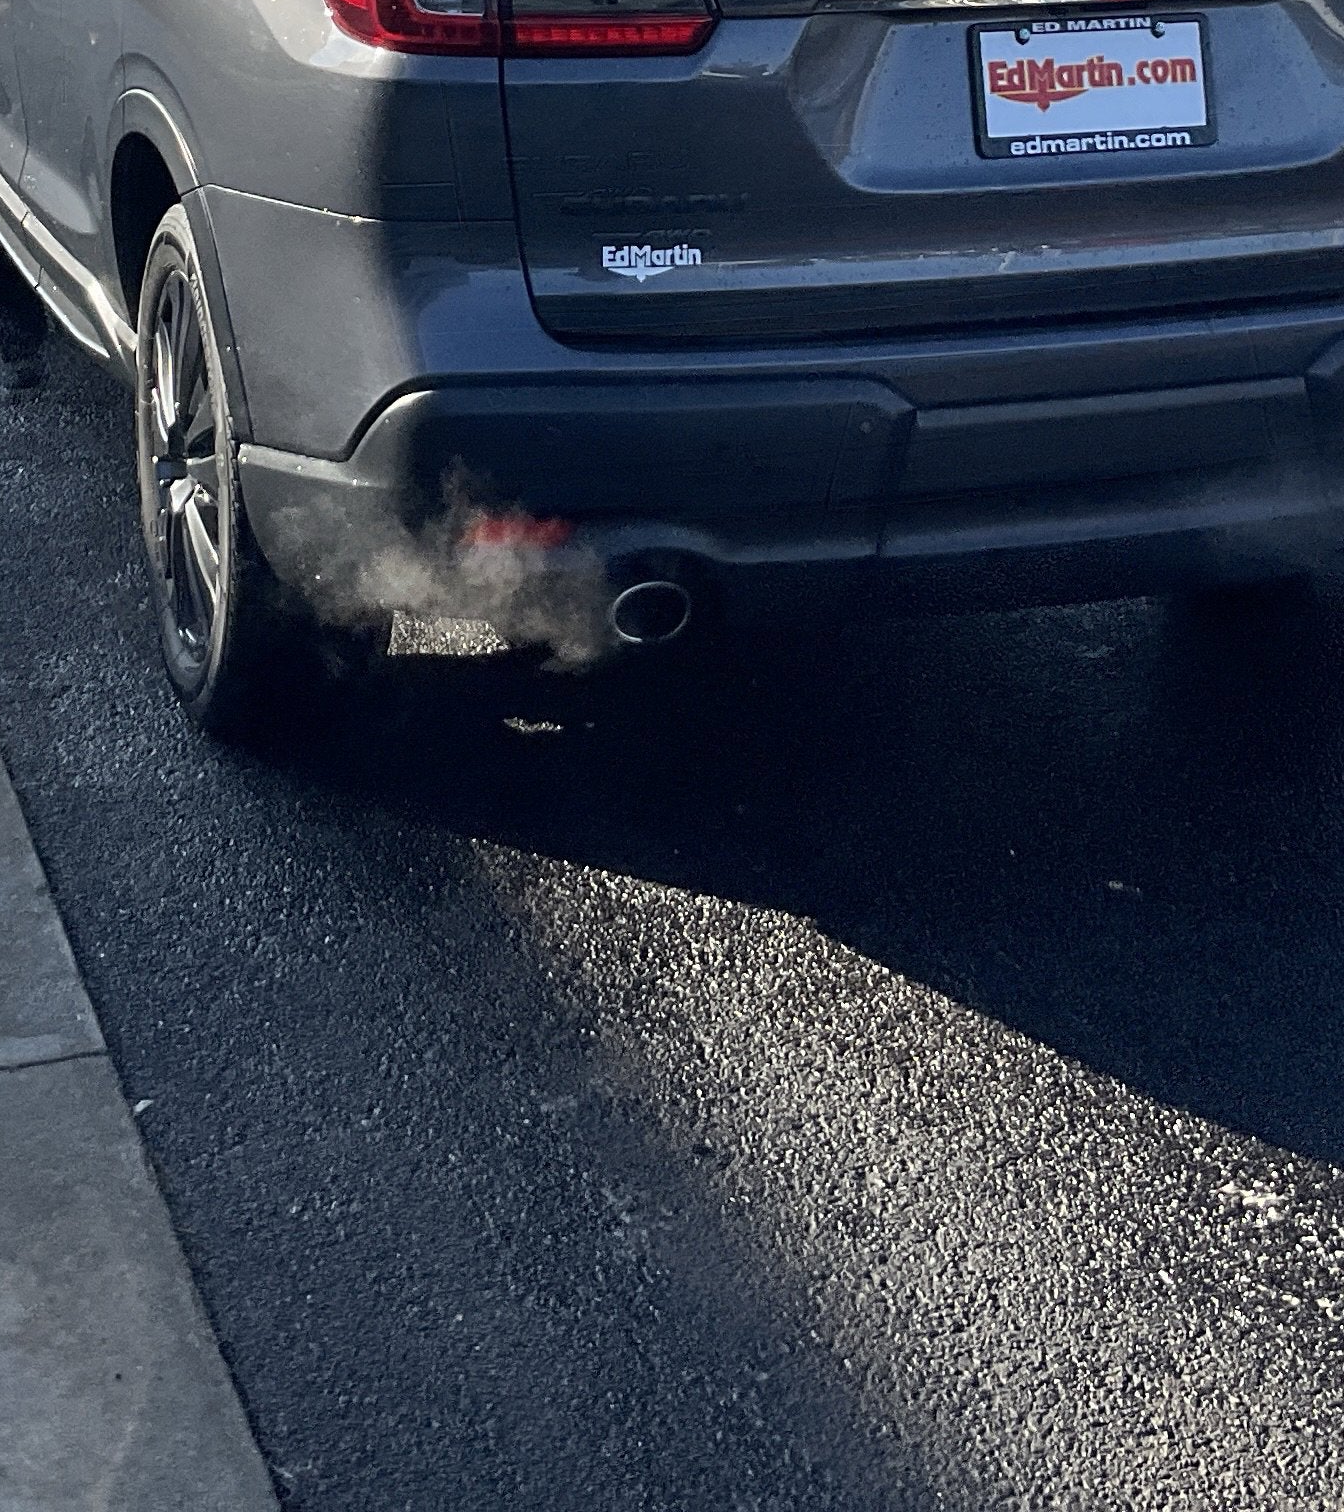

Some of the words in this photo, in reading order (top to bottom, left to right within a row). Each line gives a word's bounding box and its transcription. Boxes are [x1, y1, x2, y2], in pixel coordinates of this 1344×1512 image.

[1032, 21, 1060, 33] ED
[1067, 17, 1152, 31] MARTIN
[1010, 131, 1191, 156] edmartin.com
